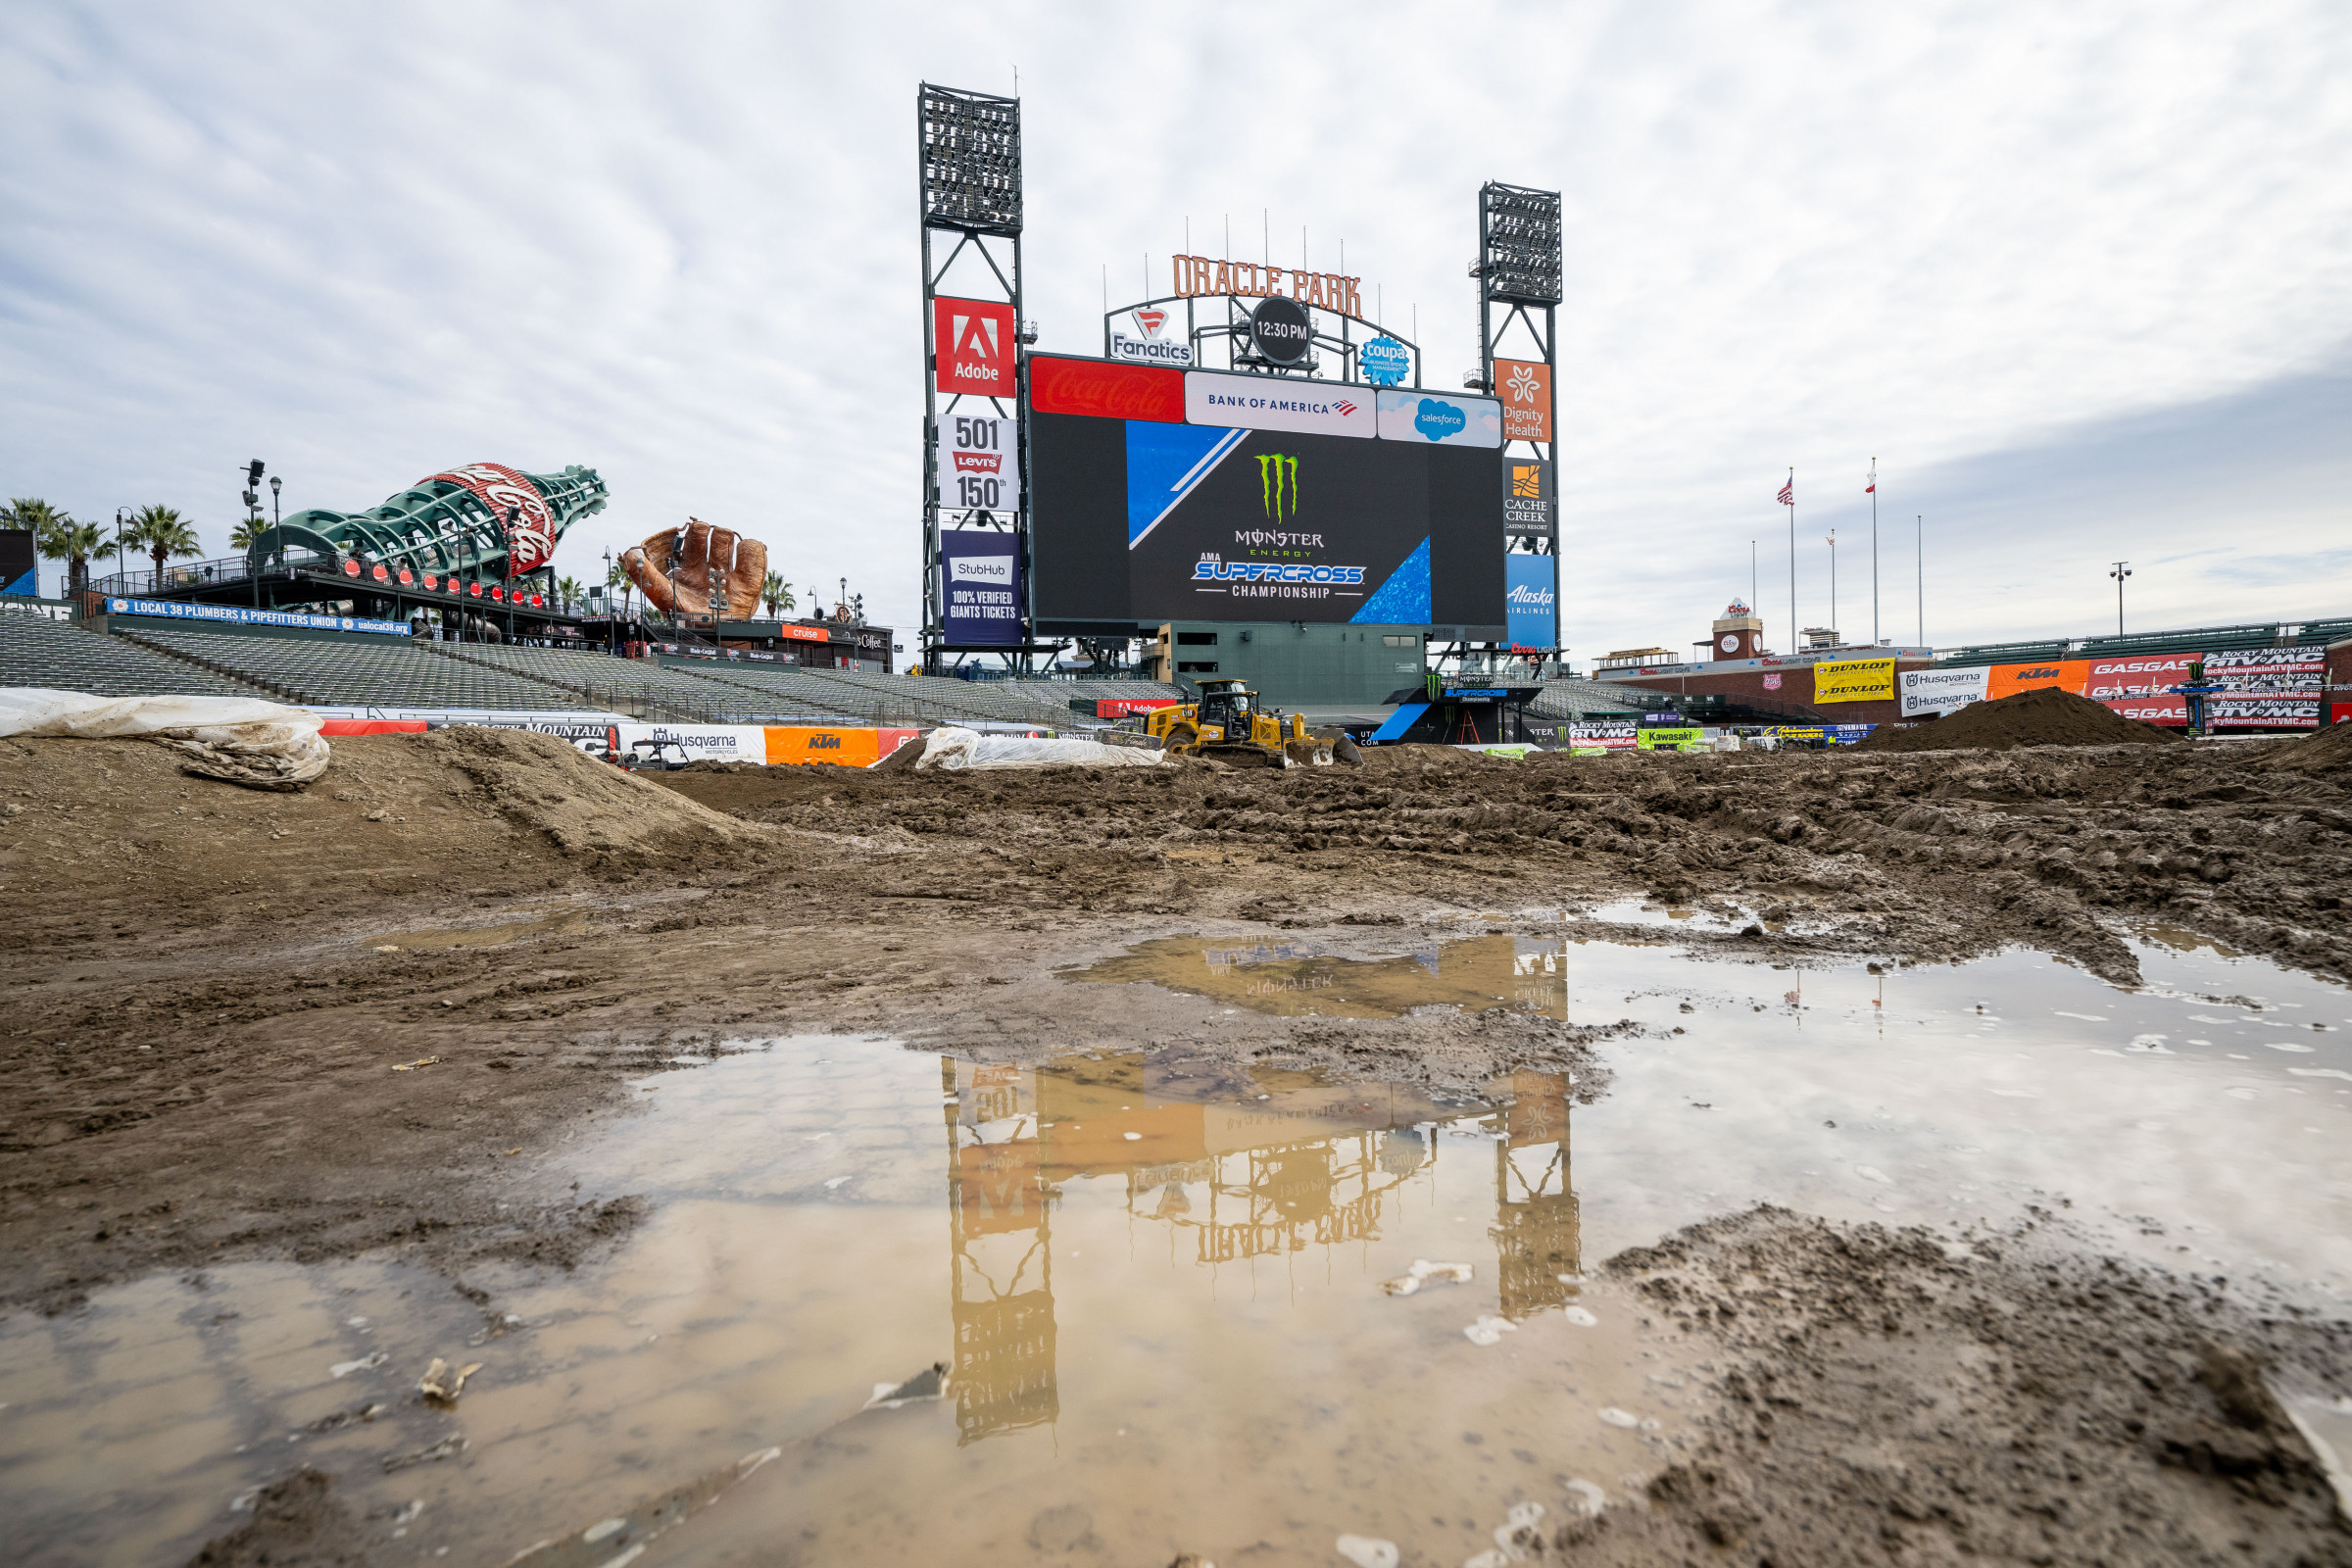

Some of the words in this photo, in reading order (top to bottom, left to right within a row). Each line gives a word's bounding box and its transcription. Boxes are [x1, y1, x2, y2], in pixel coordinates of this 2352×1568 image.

[1173, 254, 1283, 299] ORACLE
[1292, 269, 1362, 320] PARK
[1257, 321, 1288, 338] 12:30
[1290, 324, 1307, 340] PM
[1113, 334, 1191, 361] Fanatics
[1366, 345, 1406, 362] coupa
[955, 362, 999, 381] Adobe
[1208, 394, 1246, 407] BANK
[1250, 398, 1266, 409] OF
[1269, 400, 1329, 415] AMERICA
[1421, 414, 1461, 425] salesforce
[1504, 406, 1544, 425] Dignity
[956, 416, 998, 451] 501
[1505, 422, 1543, 437] Health
[1505, 499, 1547, 511] CACHE
[1505, 511, 1546, 522] CREEK
[1235, 529, 1324, 548] MONSTER
[1200, 552, 1221, 562] AMA
[1250, 549, 1311, 558] ENERGY
[958, 564, 1005, 575] StubHub
[1191, 562, 1367, 585] SUPERCROSS
[952, 591, 975, 604] 100%
[976, 592, 1013, 605] VERIFIED
[1232, 585, 1330, 599] CHAMPIONSHIP
[1507, 584, 1554, 606] Alaska
[950, 606, 980, 618] GIANTS
[981, 606, 1016, 618] TICKETS
[1729, 605, 1750, 613] Coors
[134, 601, 168, 614] LOCAL
[171, 605, 183, 615] 38
[185, 606, 239, 620] PLUMBERS
[240, 611, 249, 620] &
[250, 612, 309, 625] PIPEFITTERS
[311, 616, 337, 628] UNION
[358, 621, 408, 634] ualocal38.org
[793, 627, 818, 639] cruise
[862, 634, 882, 649] Coffee
[1510, 642, 1537, 654] Coors
[2223, 649, 2259, 658] ROCKY
[2260, 646, 2326, 656] MOUNTAIN
[1829, 662, 1890, 672] DUNLOP
[2016, 666, 2060, 680] KTM
[2093, 660, 2195, 675] GASGAS
[1459, 674, 1494, 683] MONSTER
[1919, 673, 1981, 684] Husqvarna
[1830, 685, 1890, 694] DUNLOP
[2210, 690, 2321, 700] ckyMountainATVMC.com
[1919, 694, 1978, 706] Husqvarna
[2113, 708, 2186, 718] SGAS
[2213, 717, 2319, 726] kyMountainATVMC.com
[670, 733, 737, 749] Husqvarna
[808, 733, 841, 749] KTM
[1649, 732, 1692, 741] Kawasaki
